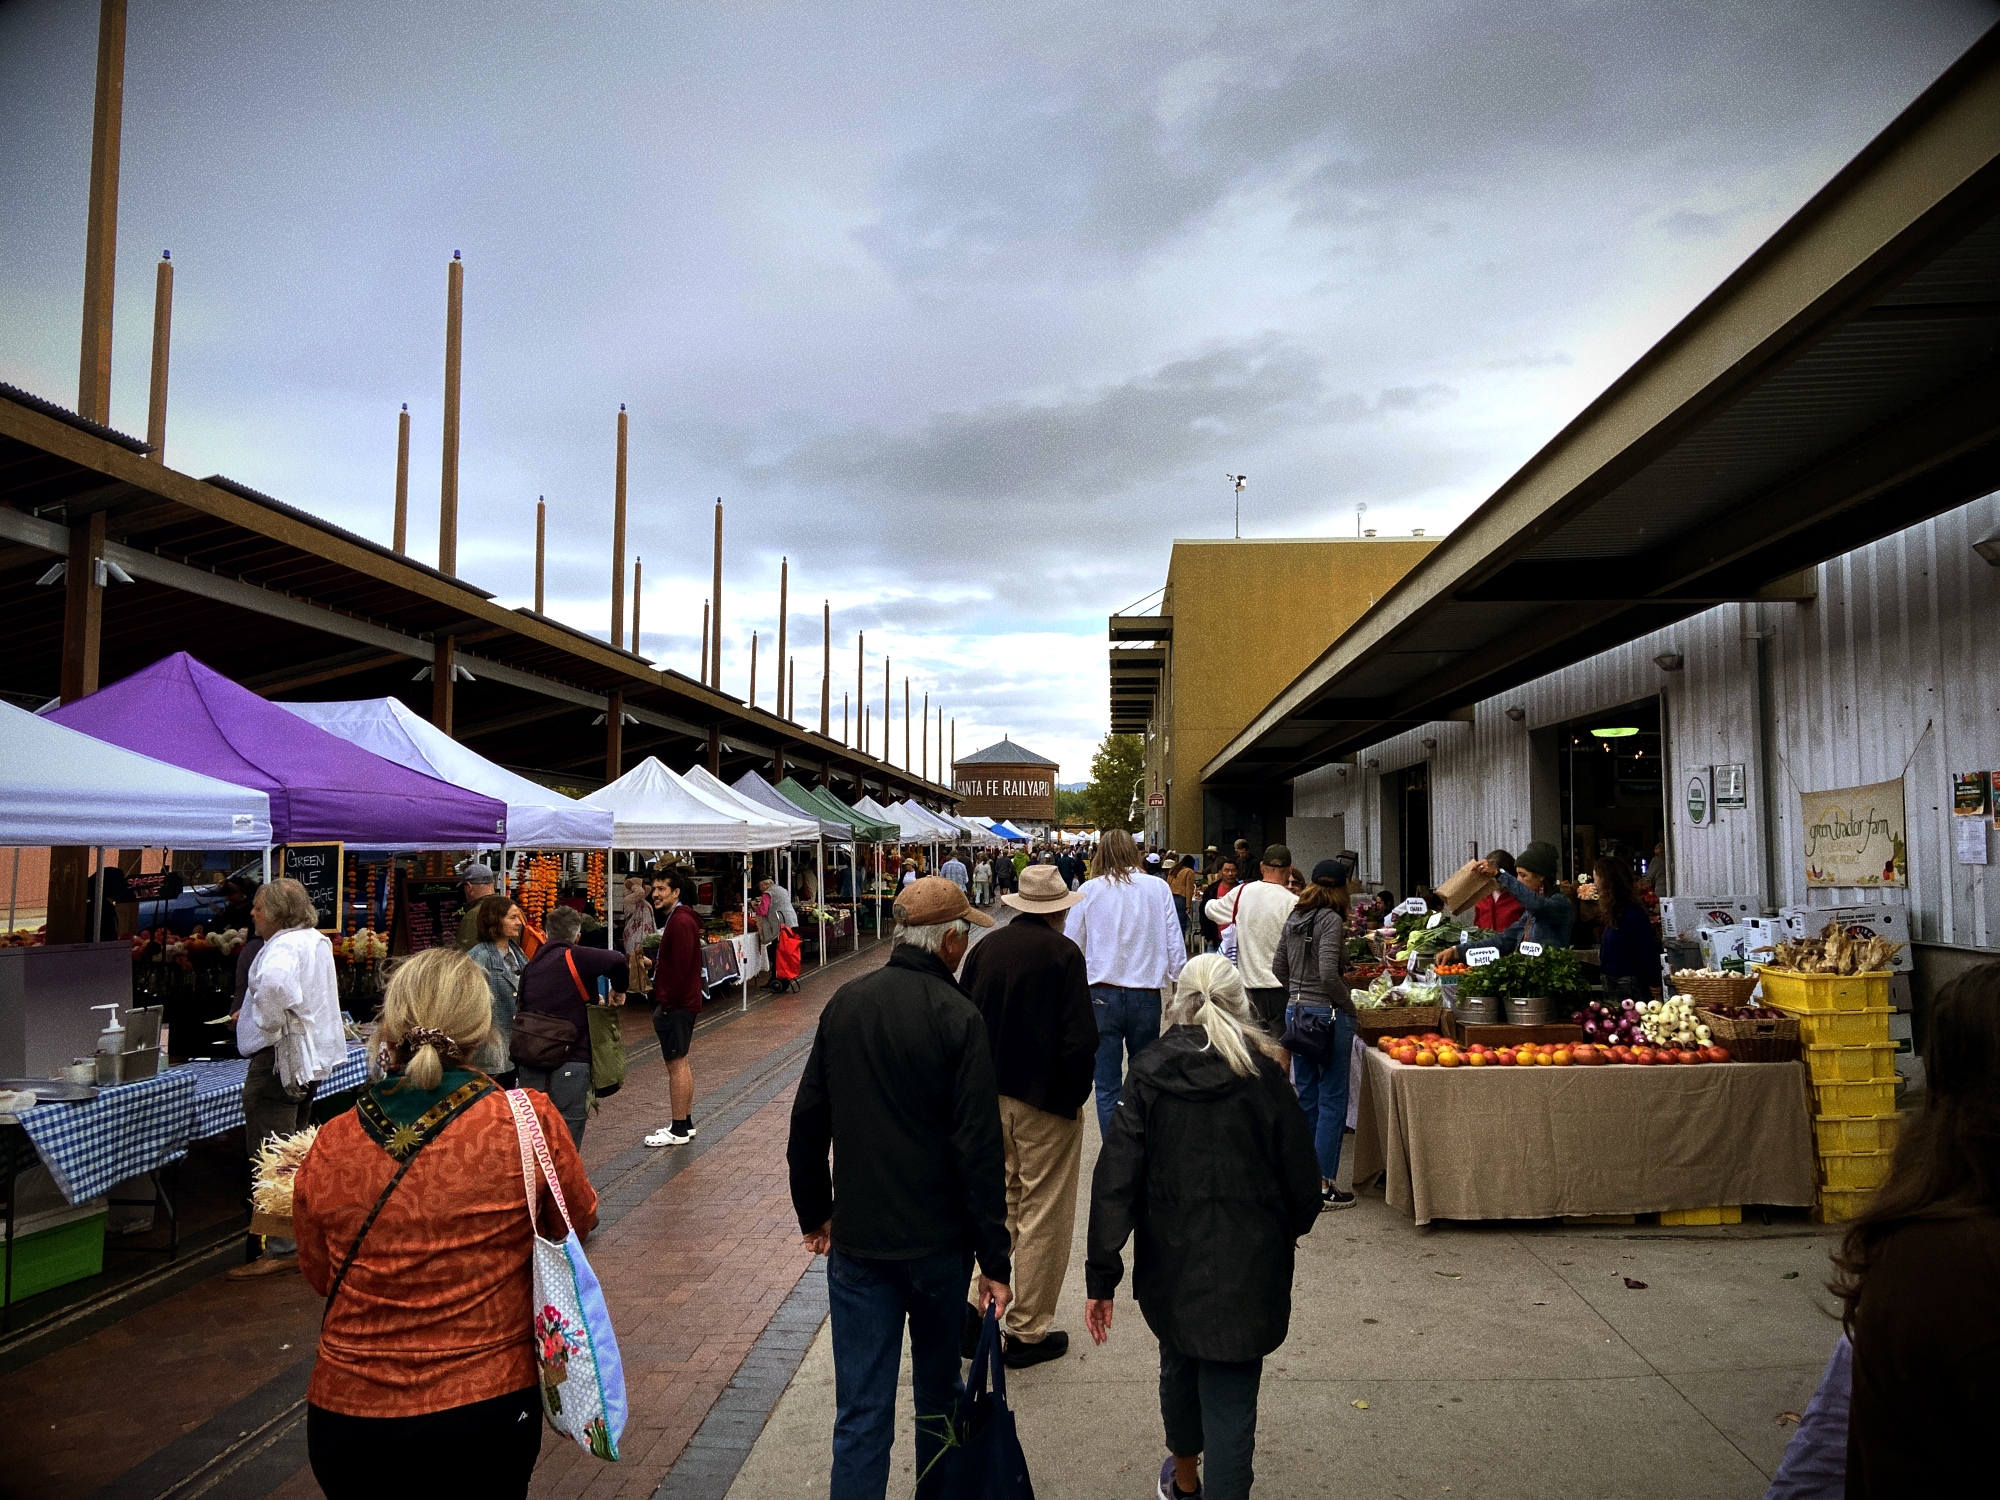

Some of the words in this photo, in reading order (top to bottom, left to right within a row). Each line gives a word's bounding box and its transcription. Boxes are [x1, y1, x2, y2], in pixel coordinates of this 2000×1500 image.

[957, 780, 983, 796] SANTA
[986, 780, 999, 796] FE
[1003, 780, 1050, 797] RAILYARD
[1805, 824, 1837, 857] green
[1835, 809, 1864, 840] tractor
[1857, 808, 1894, 854] farm
[286, 849, 325, 868] GREEN
